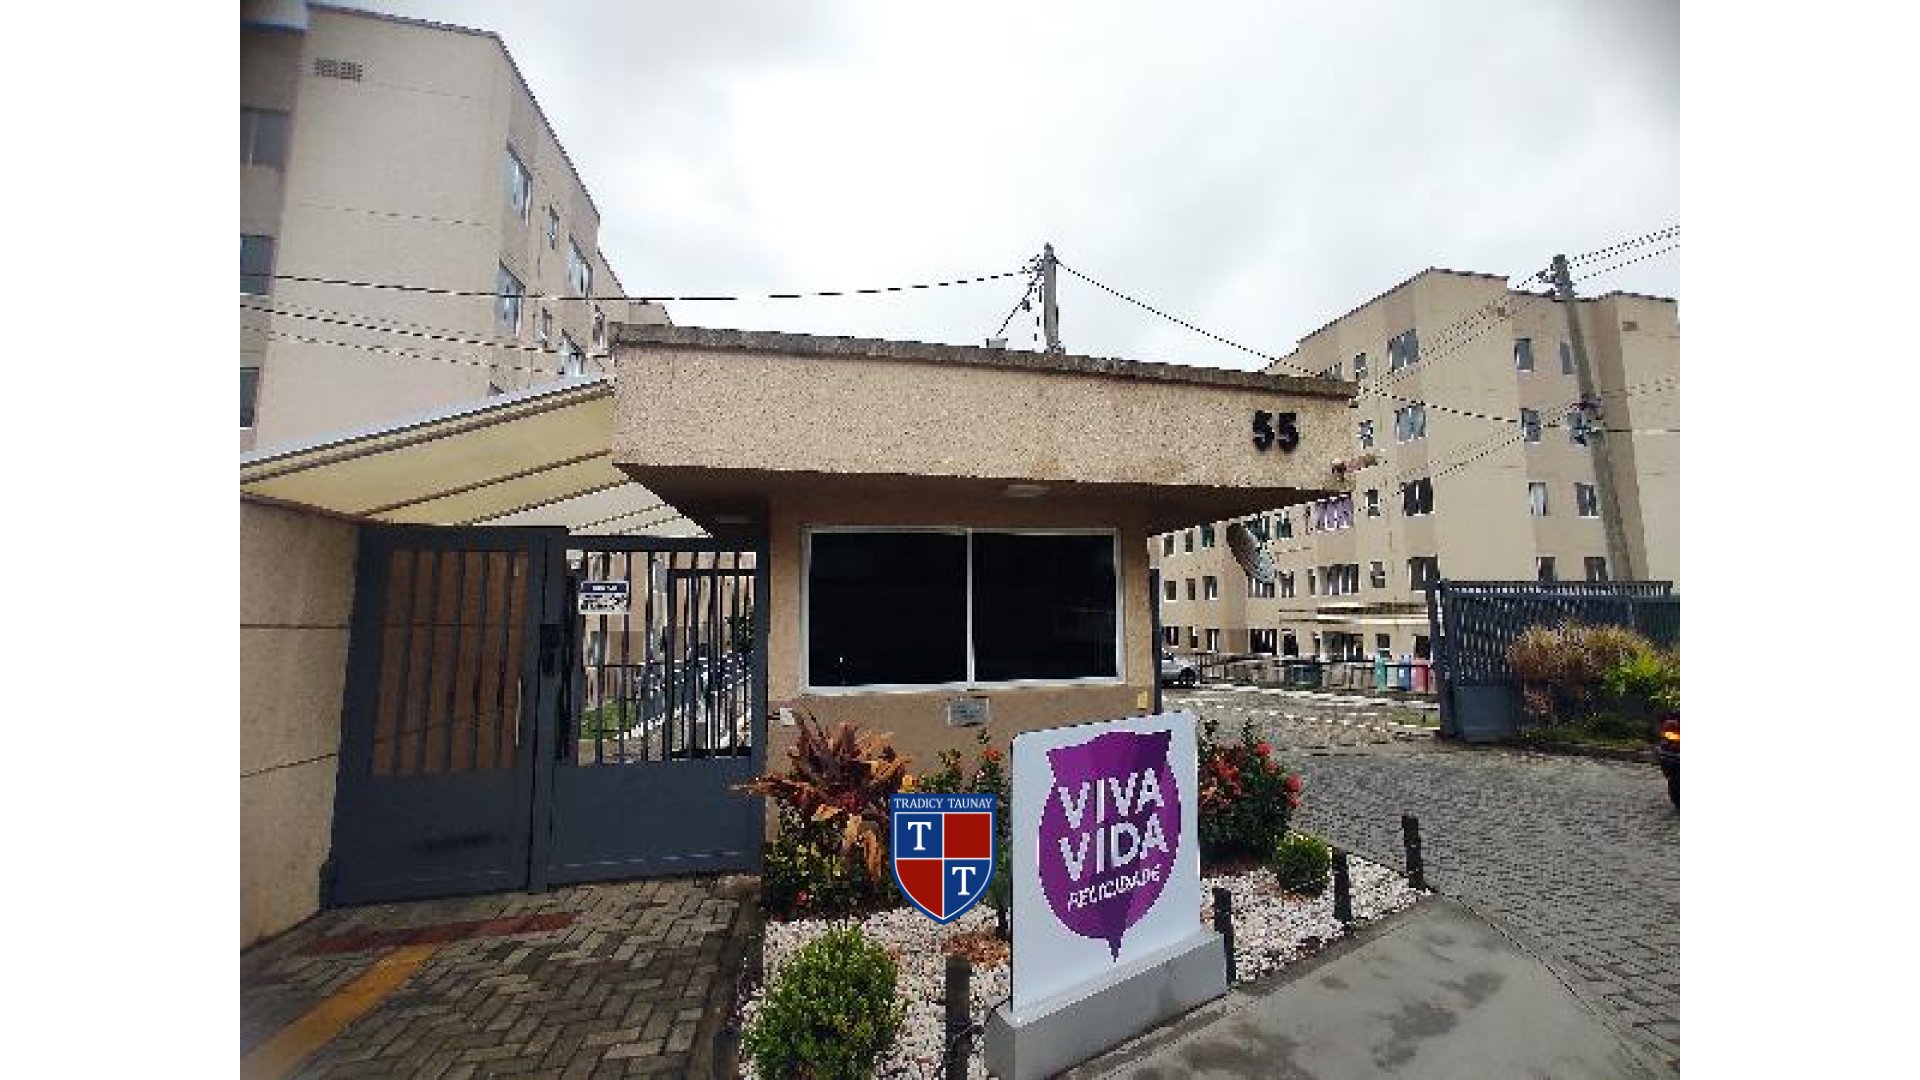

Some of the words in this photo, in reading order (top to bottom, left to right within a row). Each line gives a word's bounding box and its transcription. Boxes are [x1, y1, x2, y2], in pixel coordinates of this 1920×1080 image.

[1252, 410, 1299, 452] 55
[1058, 767, 1165, 829] VIVA
[1058, 813, 1169, 881] VIDA
